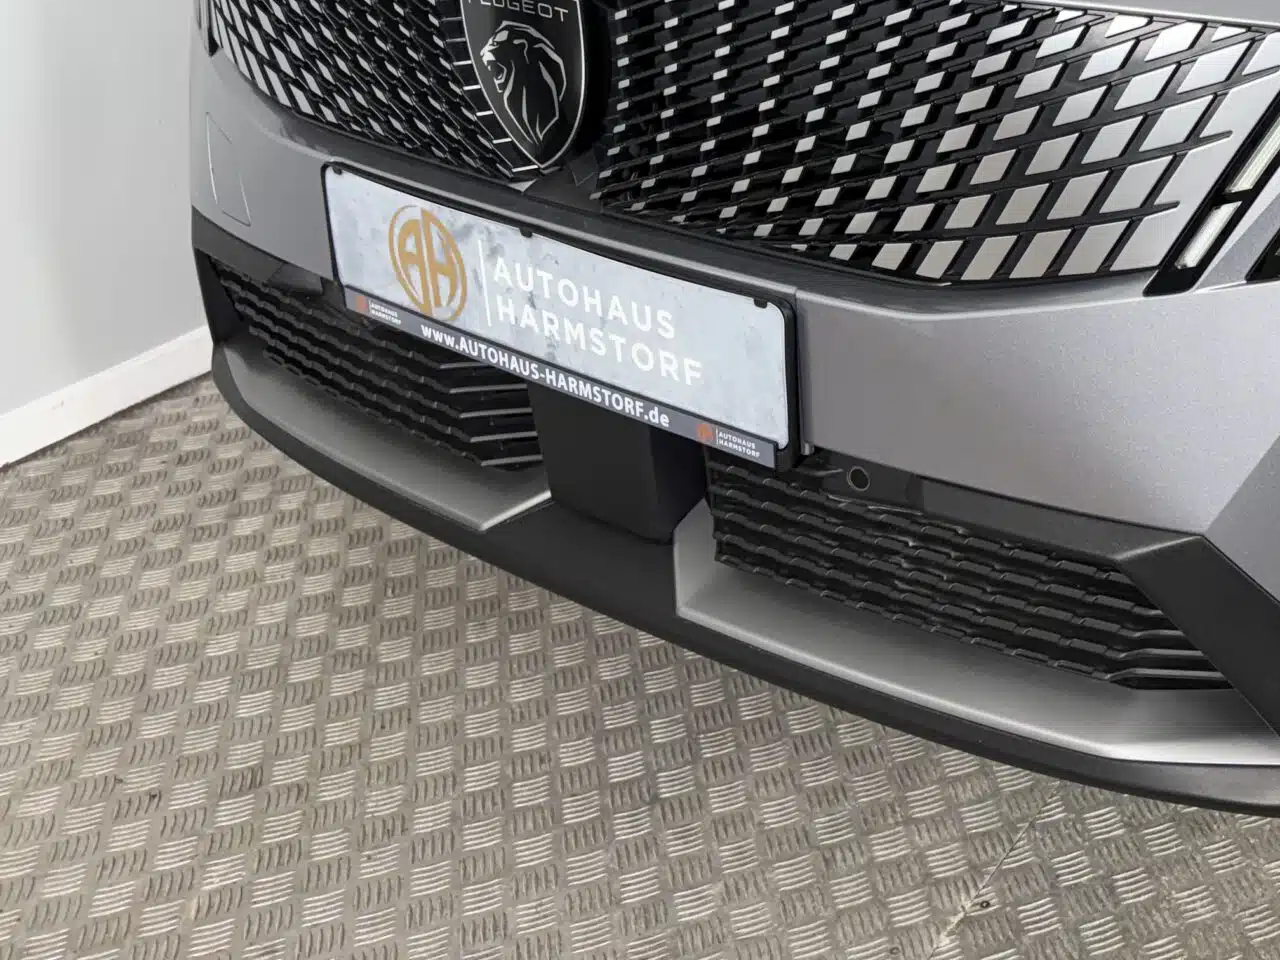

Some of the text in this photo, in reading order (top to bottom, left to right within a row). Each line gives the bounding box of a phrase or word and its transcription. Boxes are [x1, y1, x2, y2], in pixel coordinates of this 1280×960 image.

[493, 257, 675, 339] AUTOHAUS
[421, 324, 670, 428] www.AUTOHAUS-HARMSTORF.de
[496, 295, 703, 387] HARMSTORF
[718, 431, 756, 450] AUTOHAUS
[718, 439, 761, 459] HARMSTORF
